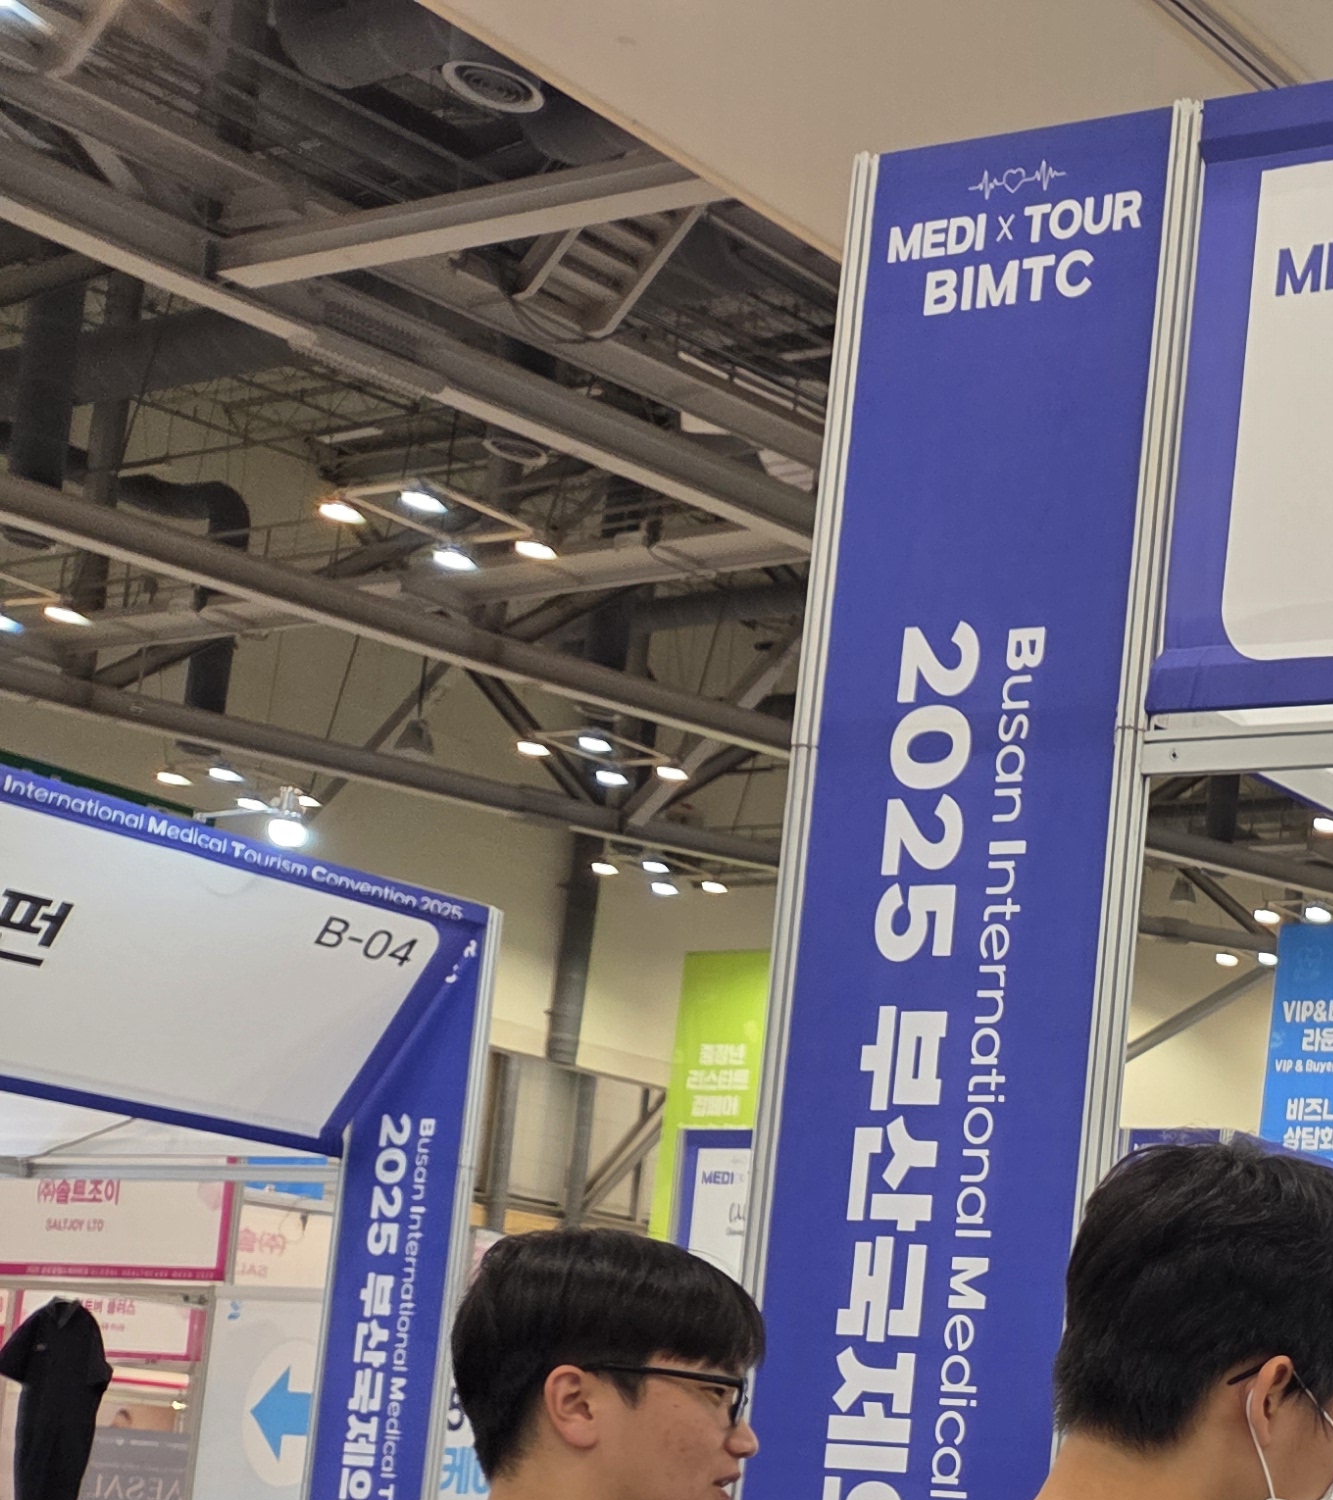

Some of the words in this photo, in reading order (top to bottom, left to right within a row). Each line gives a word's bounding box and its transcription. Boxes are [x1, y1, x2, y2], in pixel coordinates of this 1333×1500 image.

[887, 212, 985, 263] MEDI
[1025, 190, 1142, 247] TOUR
[924, 250, 1094, 315] BIMTC
[993, 626, 1046, 823] Busan
[2, 774, 144, 831] International
[147, 815, 228, 855] Medical
[230, 841, 307, 878] Tourism
[311, 866, 417, 907] Convention
[874, 620, 980, 962] 2025
[314, 916, 419, 968] B-04
[954, 840, 1027, 1238] International
[1275, 1059, 1293, 1073] VIP
[1295, 1060, 1303, 1073] &
[367, 1113, 412, 1256] 2025
[411, 1118, 436, 1200] Busan
[702, 1170, 735, 1185] MEDI
[391, 1206, 427, 1372] International
[380, 1377, 408, 1478] Medical
[930, 1257, 990, 1500] Medical
